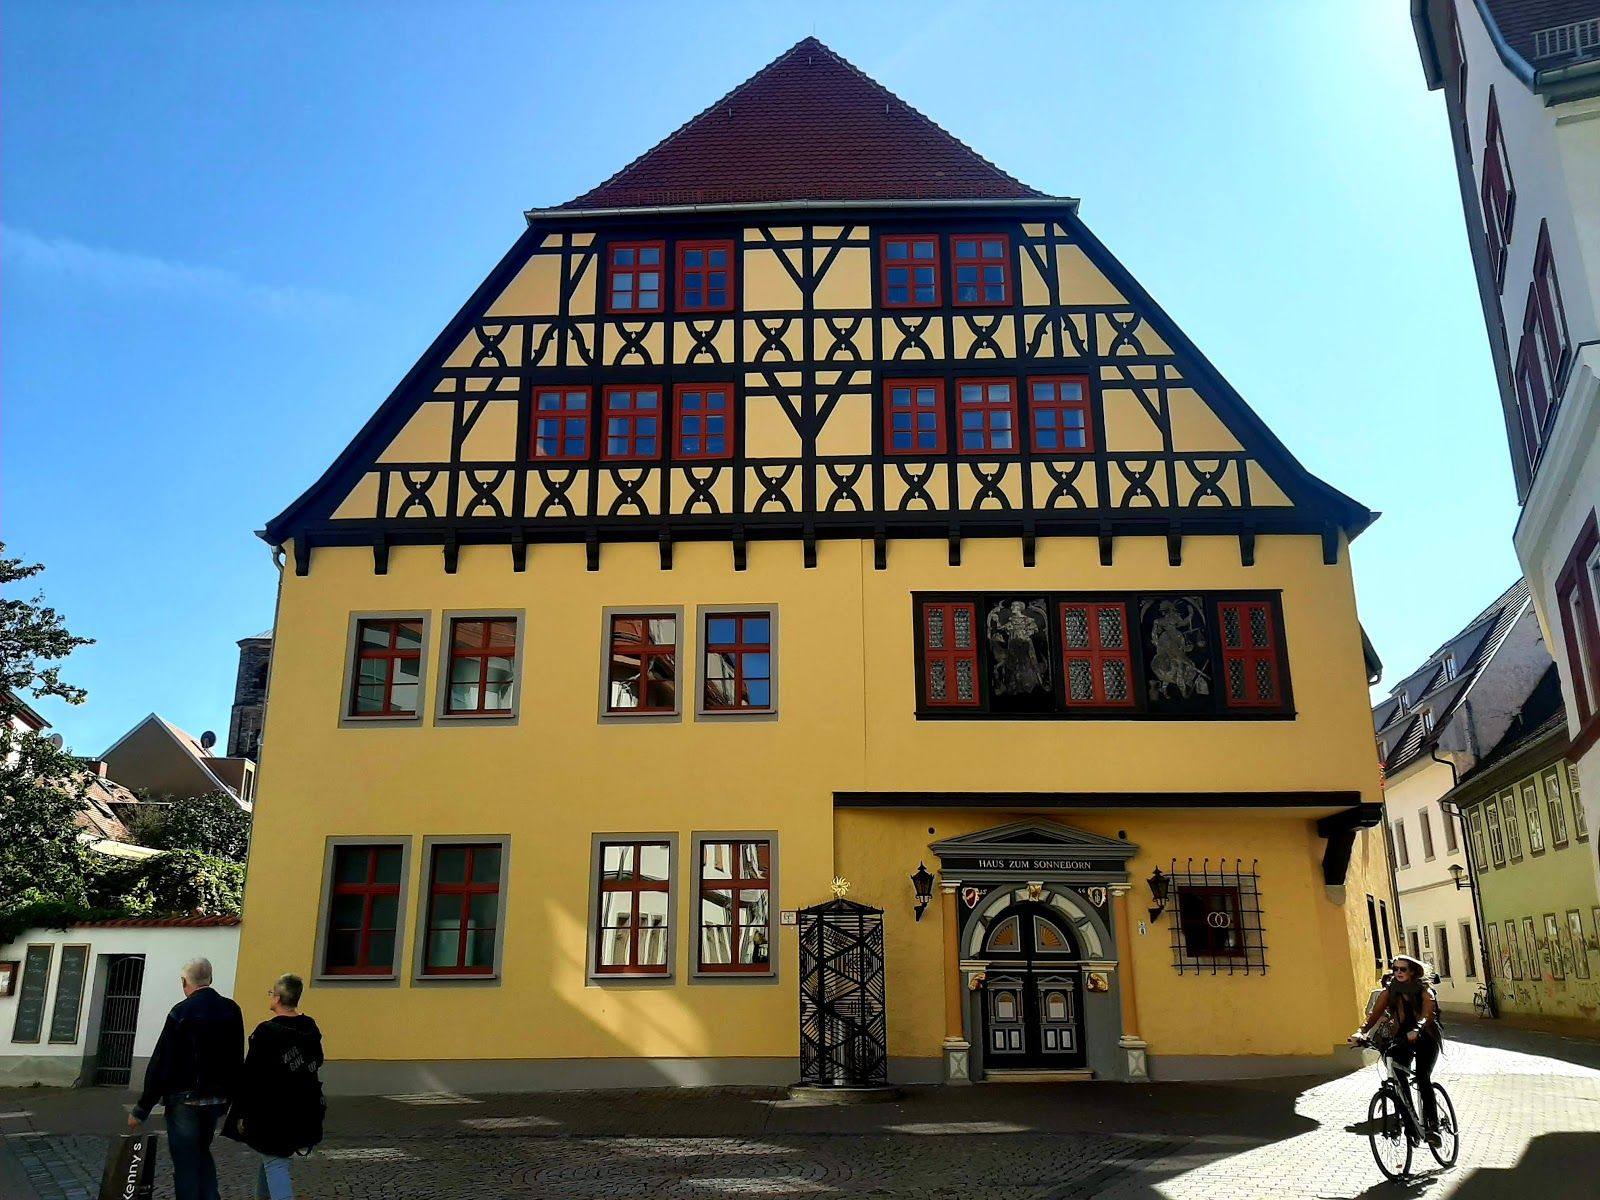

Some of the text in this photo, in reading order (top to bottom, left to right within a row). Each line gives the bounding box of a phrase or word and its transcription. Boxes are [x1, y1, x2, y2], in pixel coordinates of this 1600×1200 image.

[979, 859, 1091, 869] HAUS ZUM SONNEBORN
[289, 1054, 305, 1071] GIVE
[307, 1060, 317, 1073] UP
